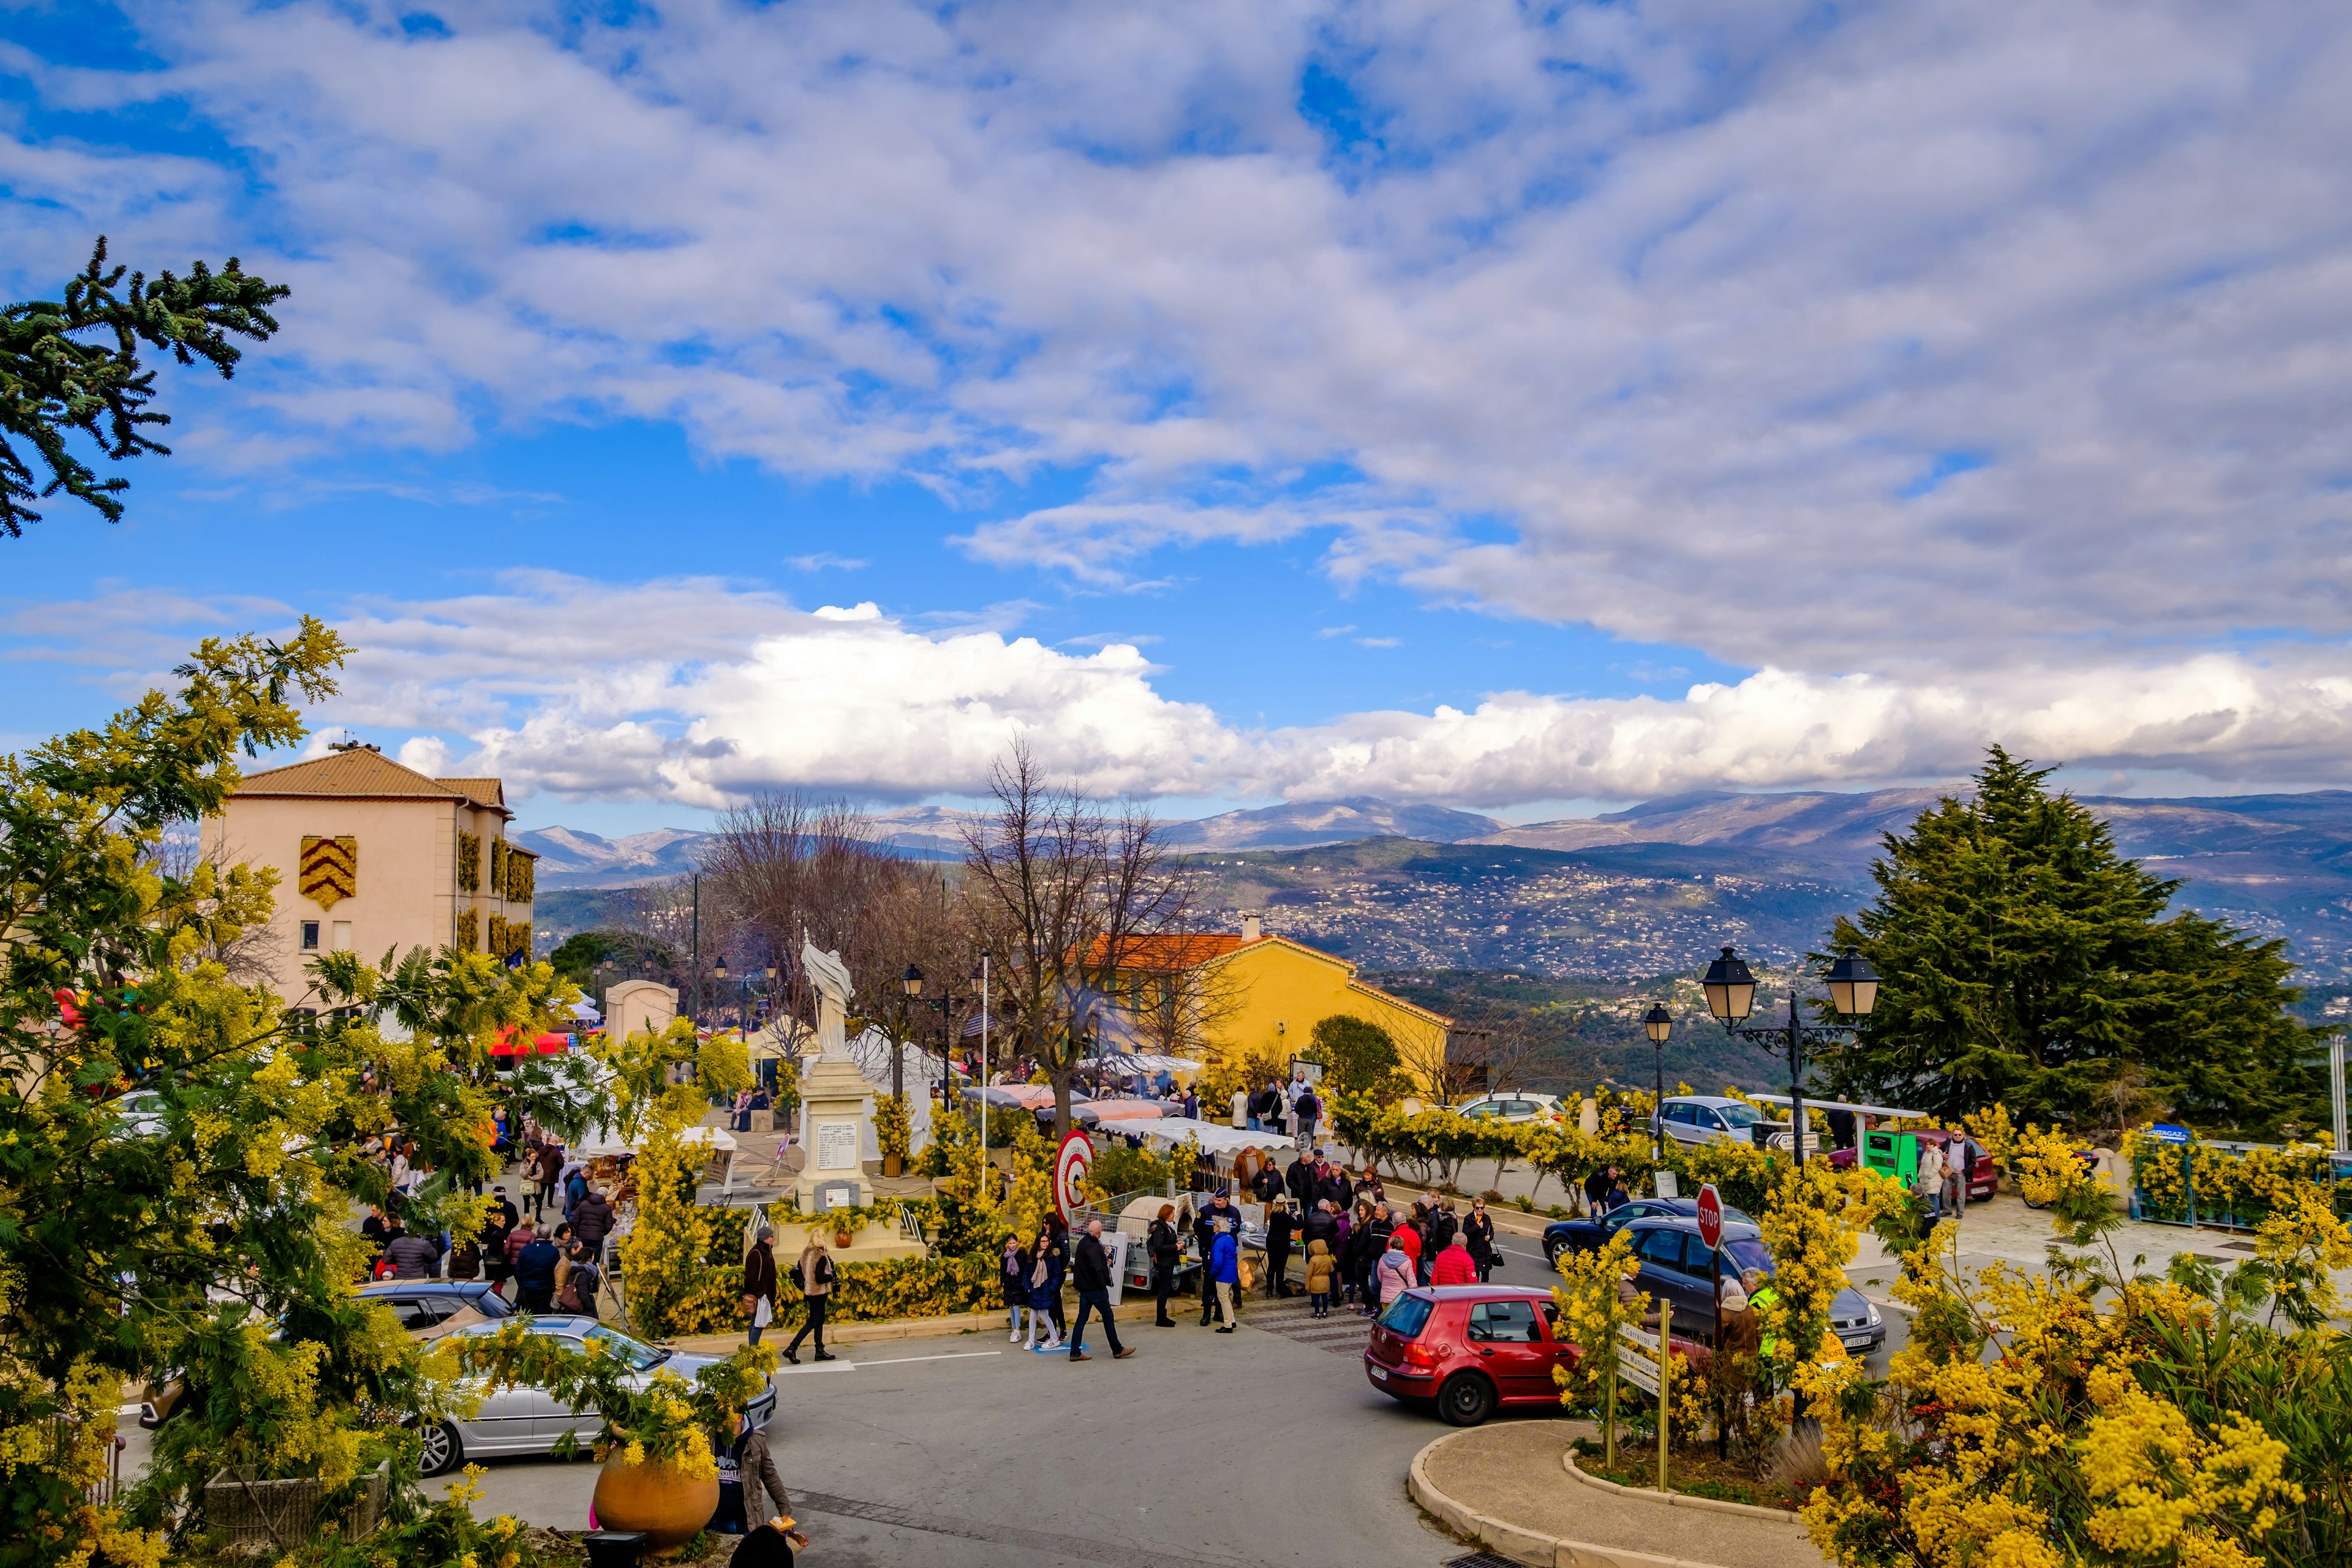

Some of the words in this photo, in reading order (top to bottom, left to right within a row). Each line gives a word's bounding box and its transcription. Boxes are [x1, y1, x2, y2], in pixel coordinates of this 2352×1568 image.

[1699, 1206, 1719, 1229] STOP
[1626, 1327, 1651, 1346] Carreiros
[1614, 1346, 1629, 1360] Stade
[1630, 1354, 1654, 1374] Municipal
[1617, 1365, 1628, 1377] ennis
[1629, 1371, 1654, 1390] Municipaux
